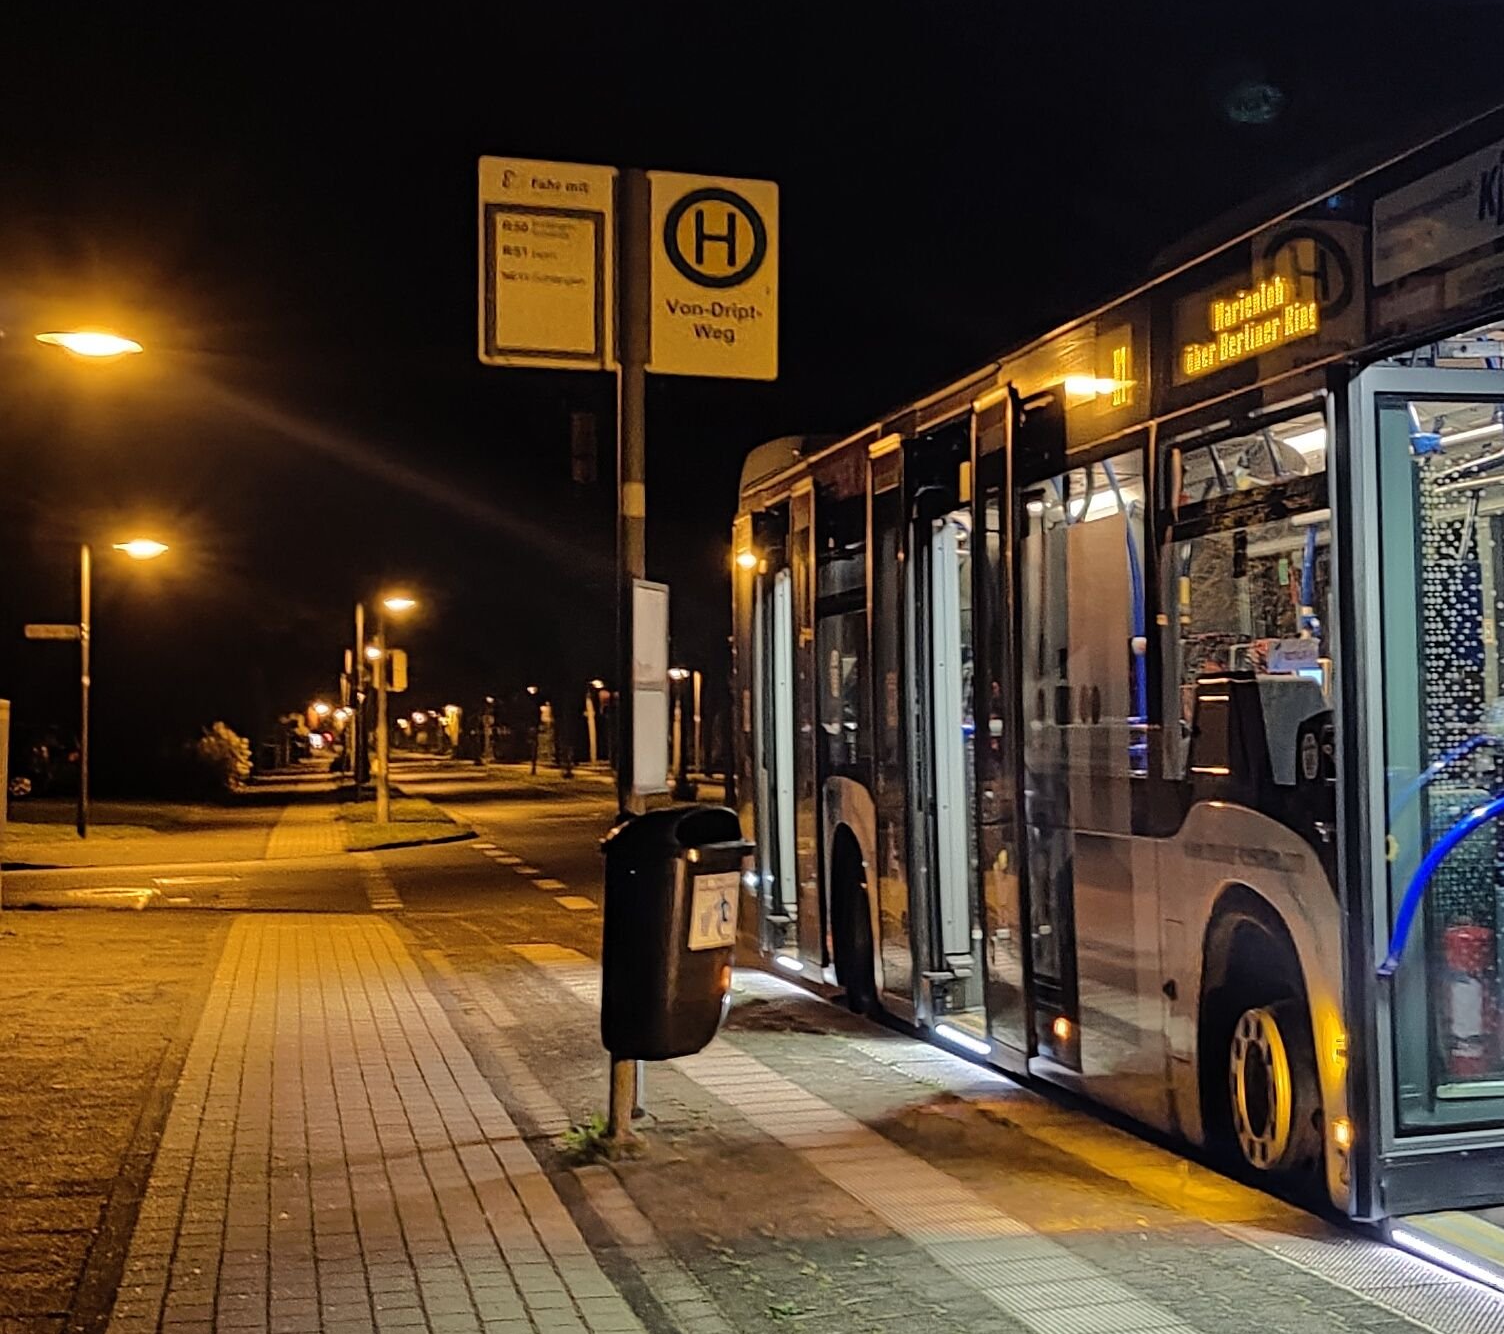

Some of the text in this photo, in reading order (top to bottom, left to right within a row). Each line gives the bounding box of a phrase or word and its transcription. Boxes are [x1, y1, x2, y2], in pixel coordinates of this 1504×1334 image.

[694, 209, 737, 267] H
[1214, 276, 1284, 332] Marienloh
[693, 322, 736, 347] Weg
[1219, 317, 1281, 361] Berliner
